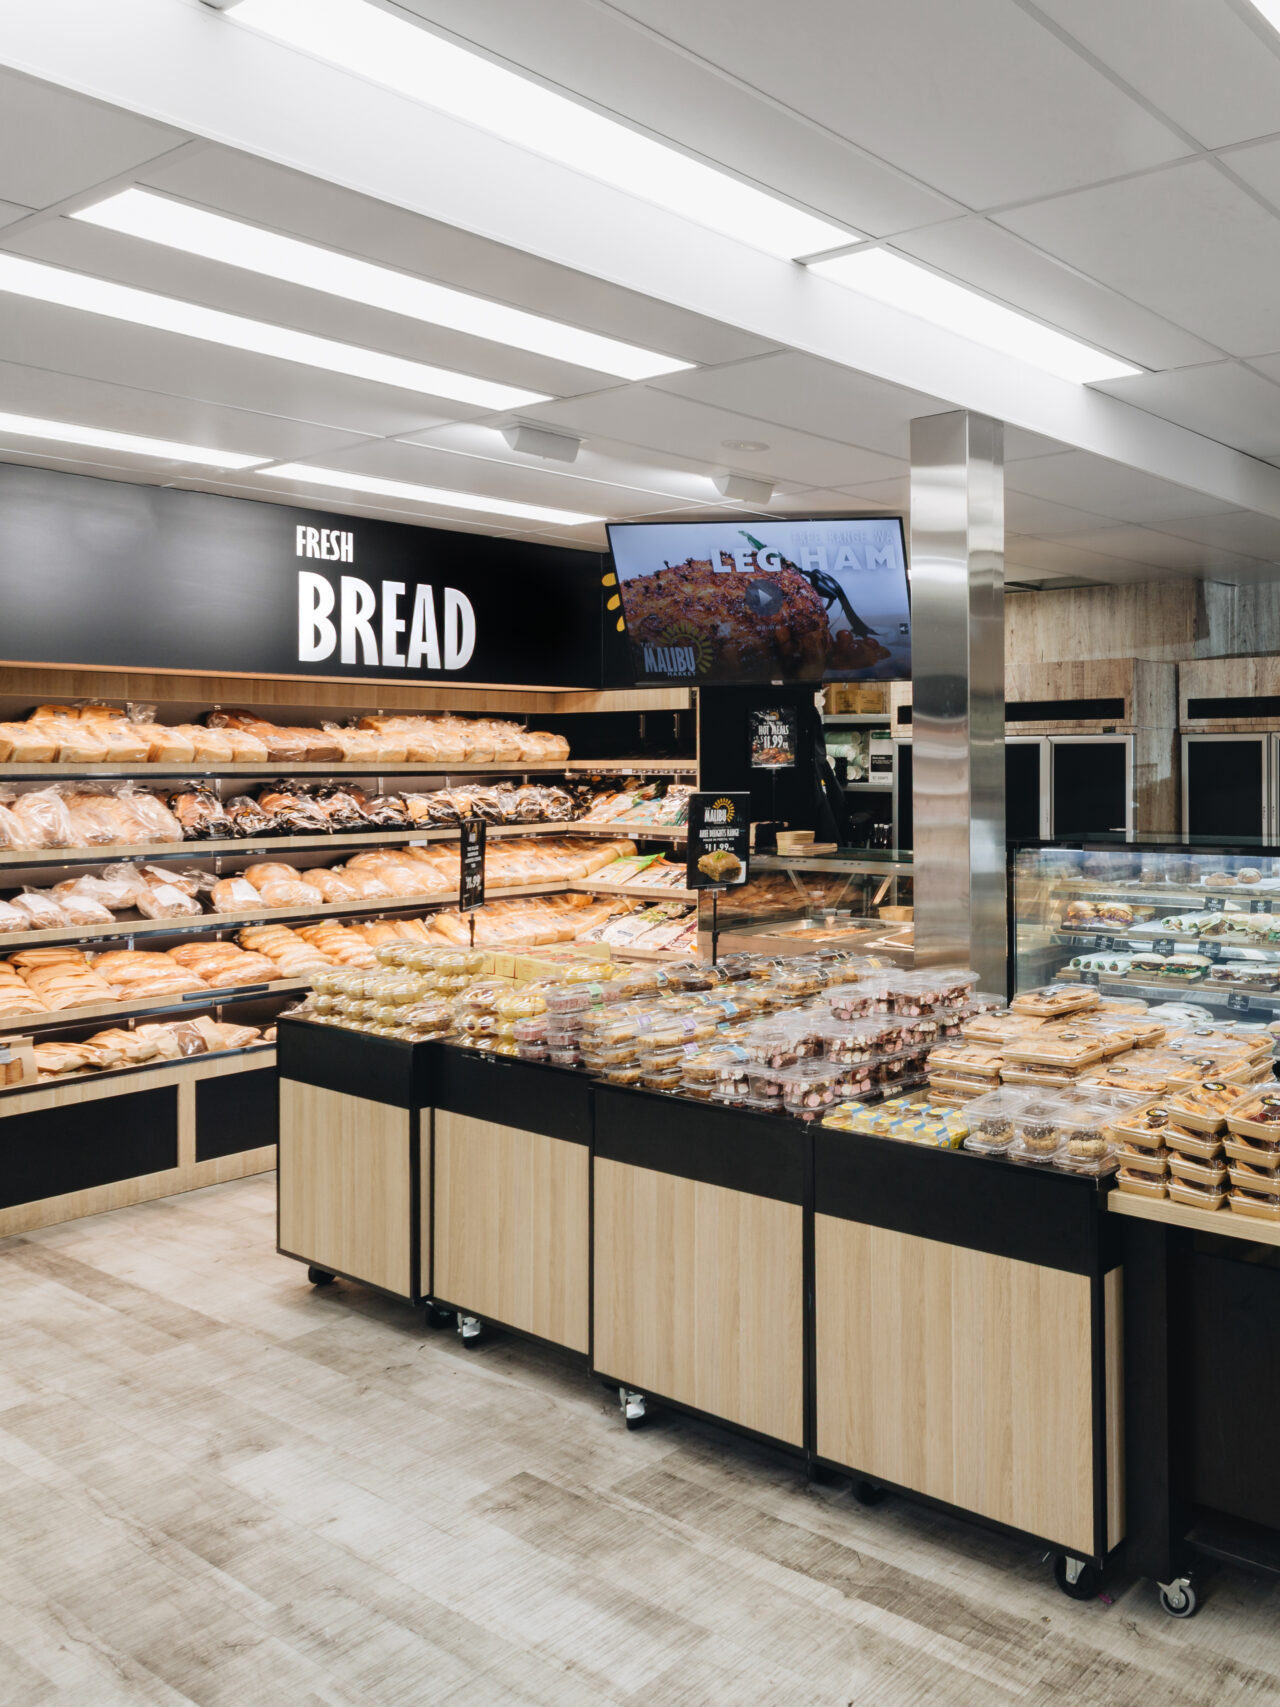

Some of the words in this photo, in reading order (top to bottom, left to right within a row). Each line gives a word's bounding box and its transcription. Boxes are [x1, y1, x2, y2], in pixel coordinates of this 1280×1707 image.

[296, 525, 354, 563] FRESH
[711, 547, 783, 573] LEG
[800, 545, 897, 570] HAM
[298, 570, 477, 670] BREAD
[644, 647, 696, 673] MALIBU
[758, 725, 769, 735] HOT
[771, 724, 789, 735] MEALS
[704, 808, 727, 823] MALIBU
